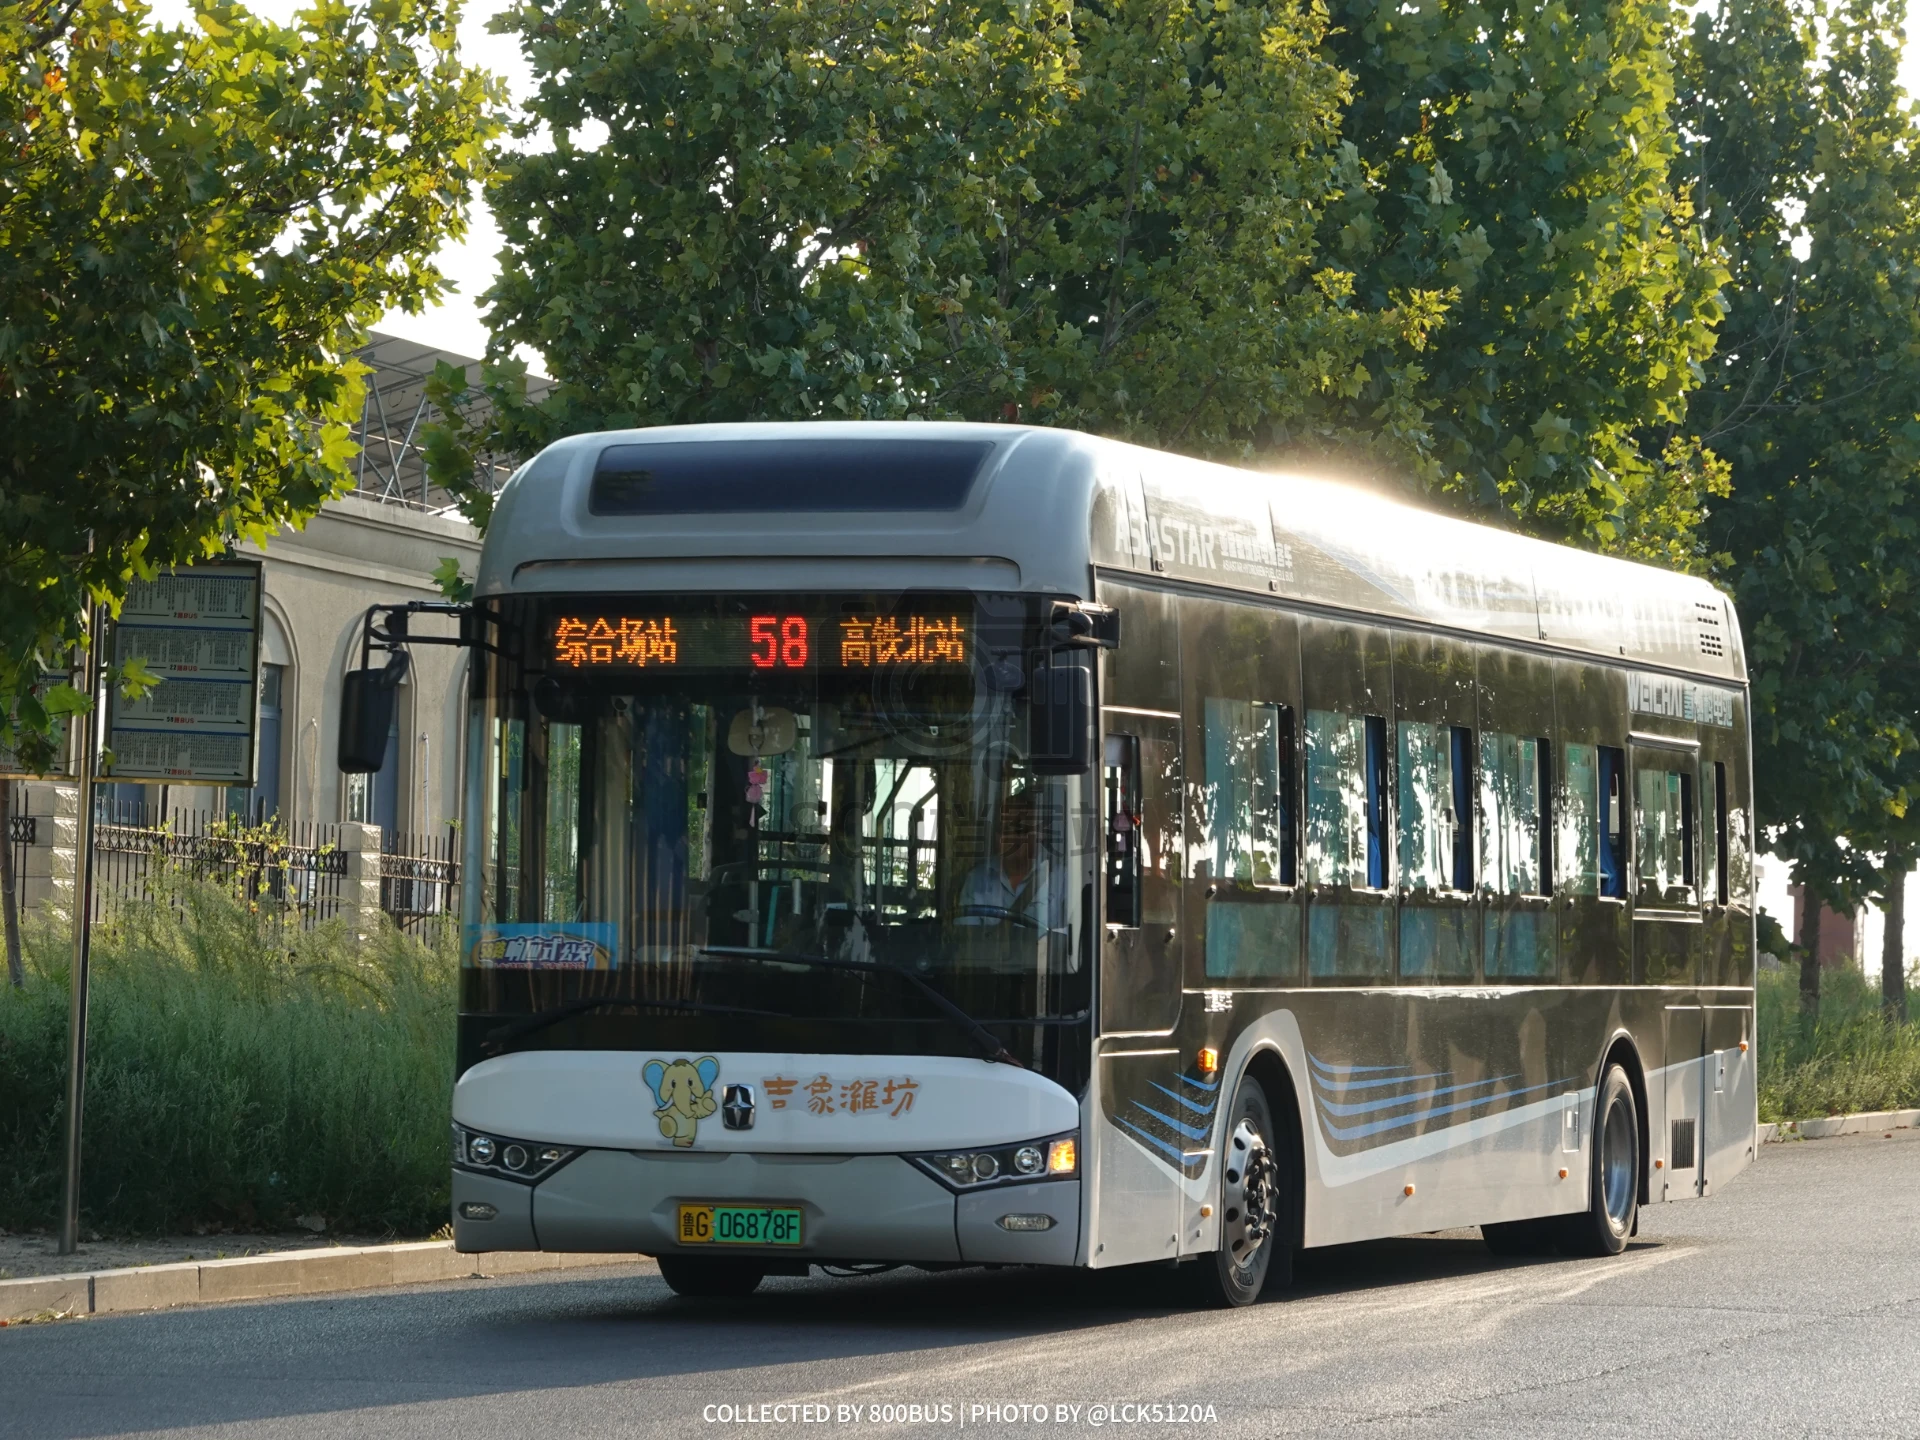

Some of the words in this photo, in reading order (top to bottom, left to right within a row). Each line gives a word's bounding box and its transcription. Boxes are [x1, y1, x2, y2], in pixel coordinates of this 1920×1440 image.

[1114, 508, 1217, 569] ASIASTAR
[555, 616, 677, 667] 综合场站
[751, 616, 807, 667] 58
[840, 616, 965, 667] 高铁北站
